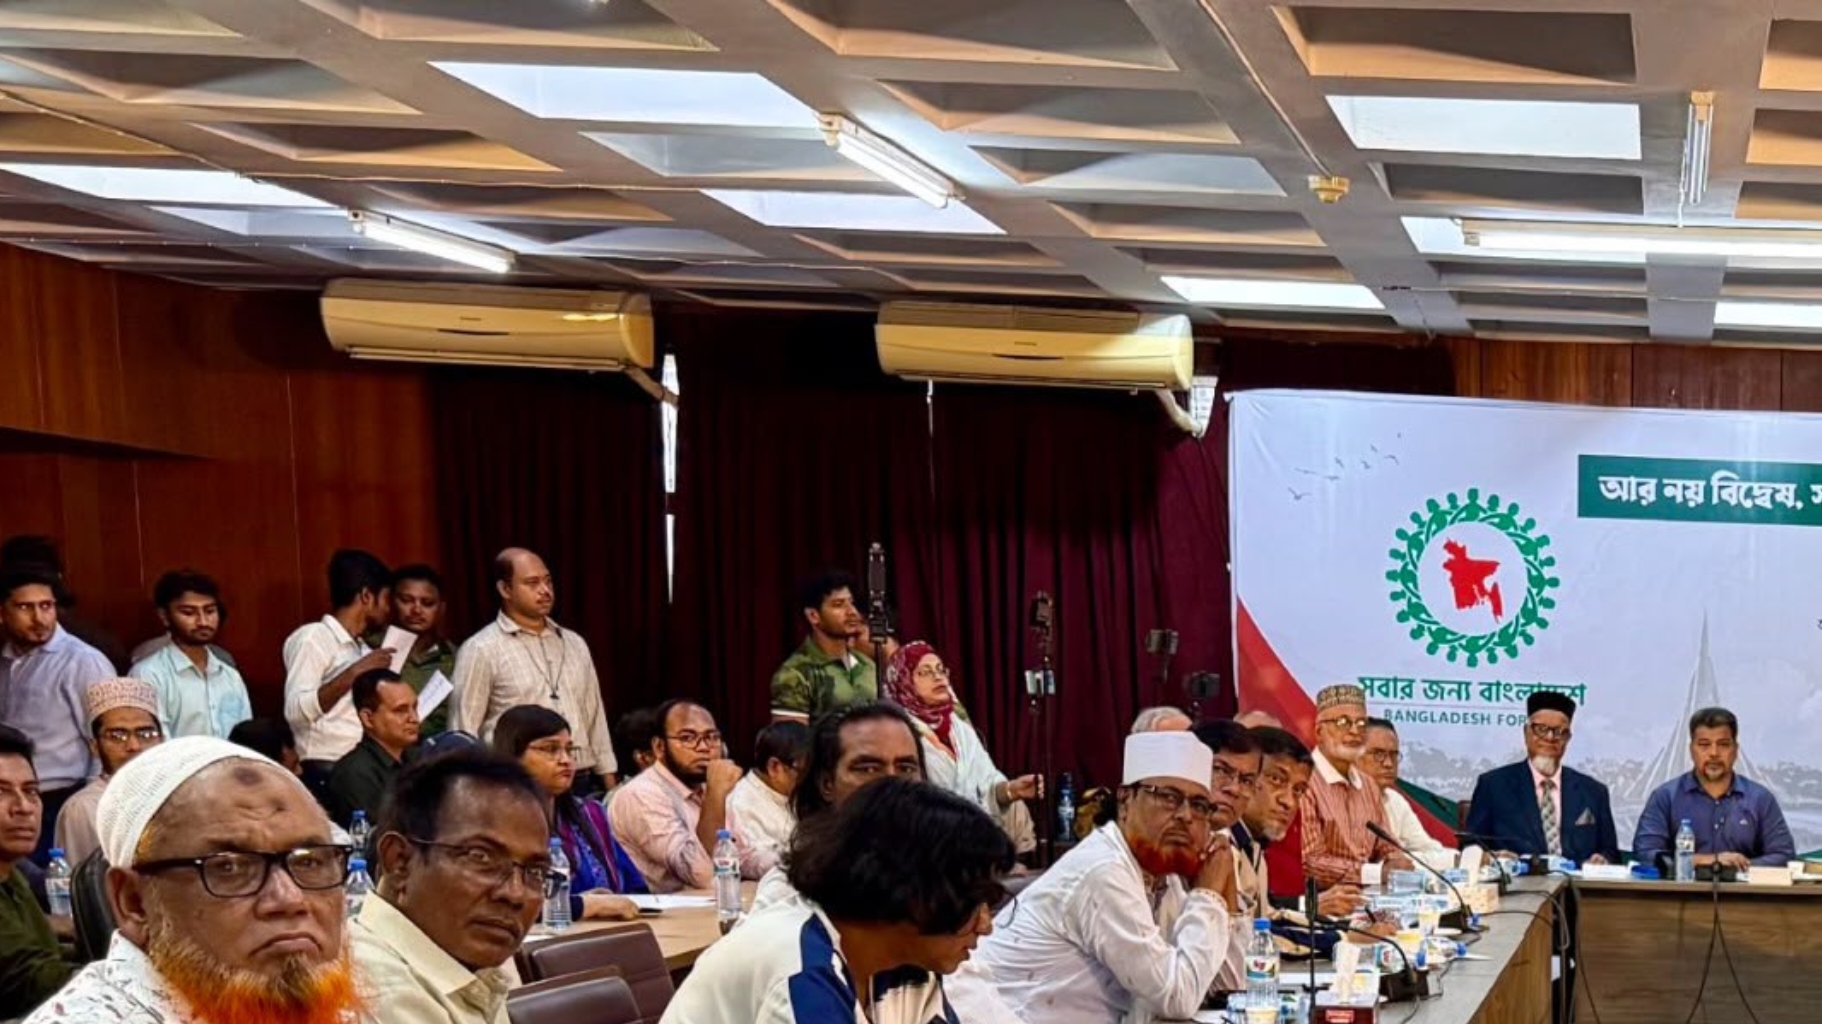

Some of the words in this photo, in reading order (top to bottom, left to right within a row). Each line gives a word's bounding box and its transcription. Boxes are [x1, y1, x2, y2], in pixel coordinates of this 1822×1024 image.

[1598, 475, 1657, 506] আর
[1662, 478, 1706, 508] নয়
[1358, 677, 1416, 701] সবার
[1421, 679, 1472, 702] জন্য
[1384, 709, 1491, 726] BANGLADESH
